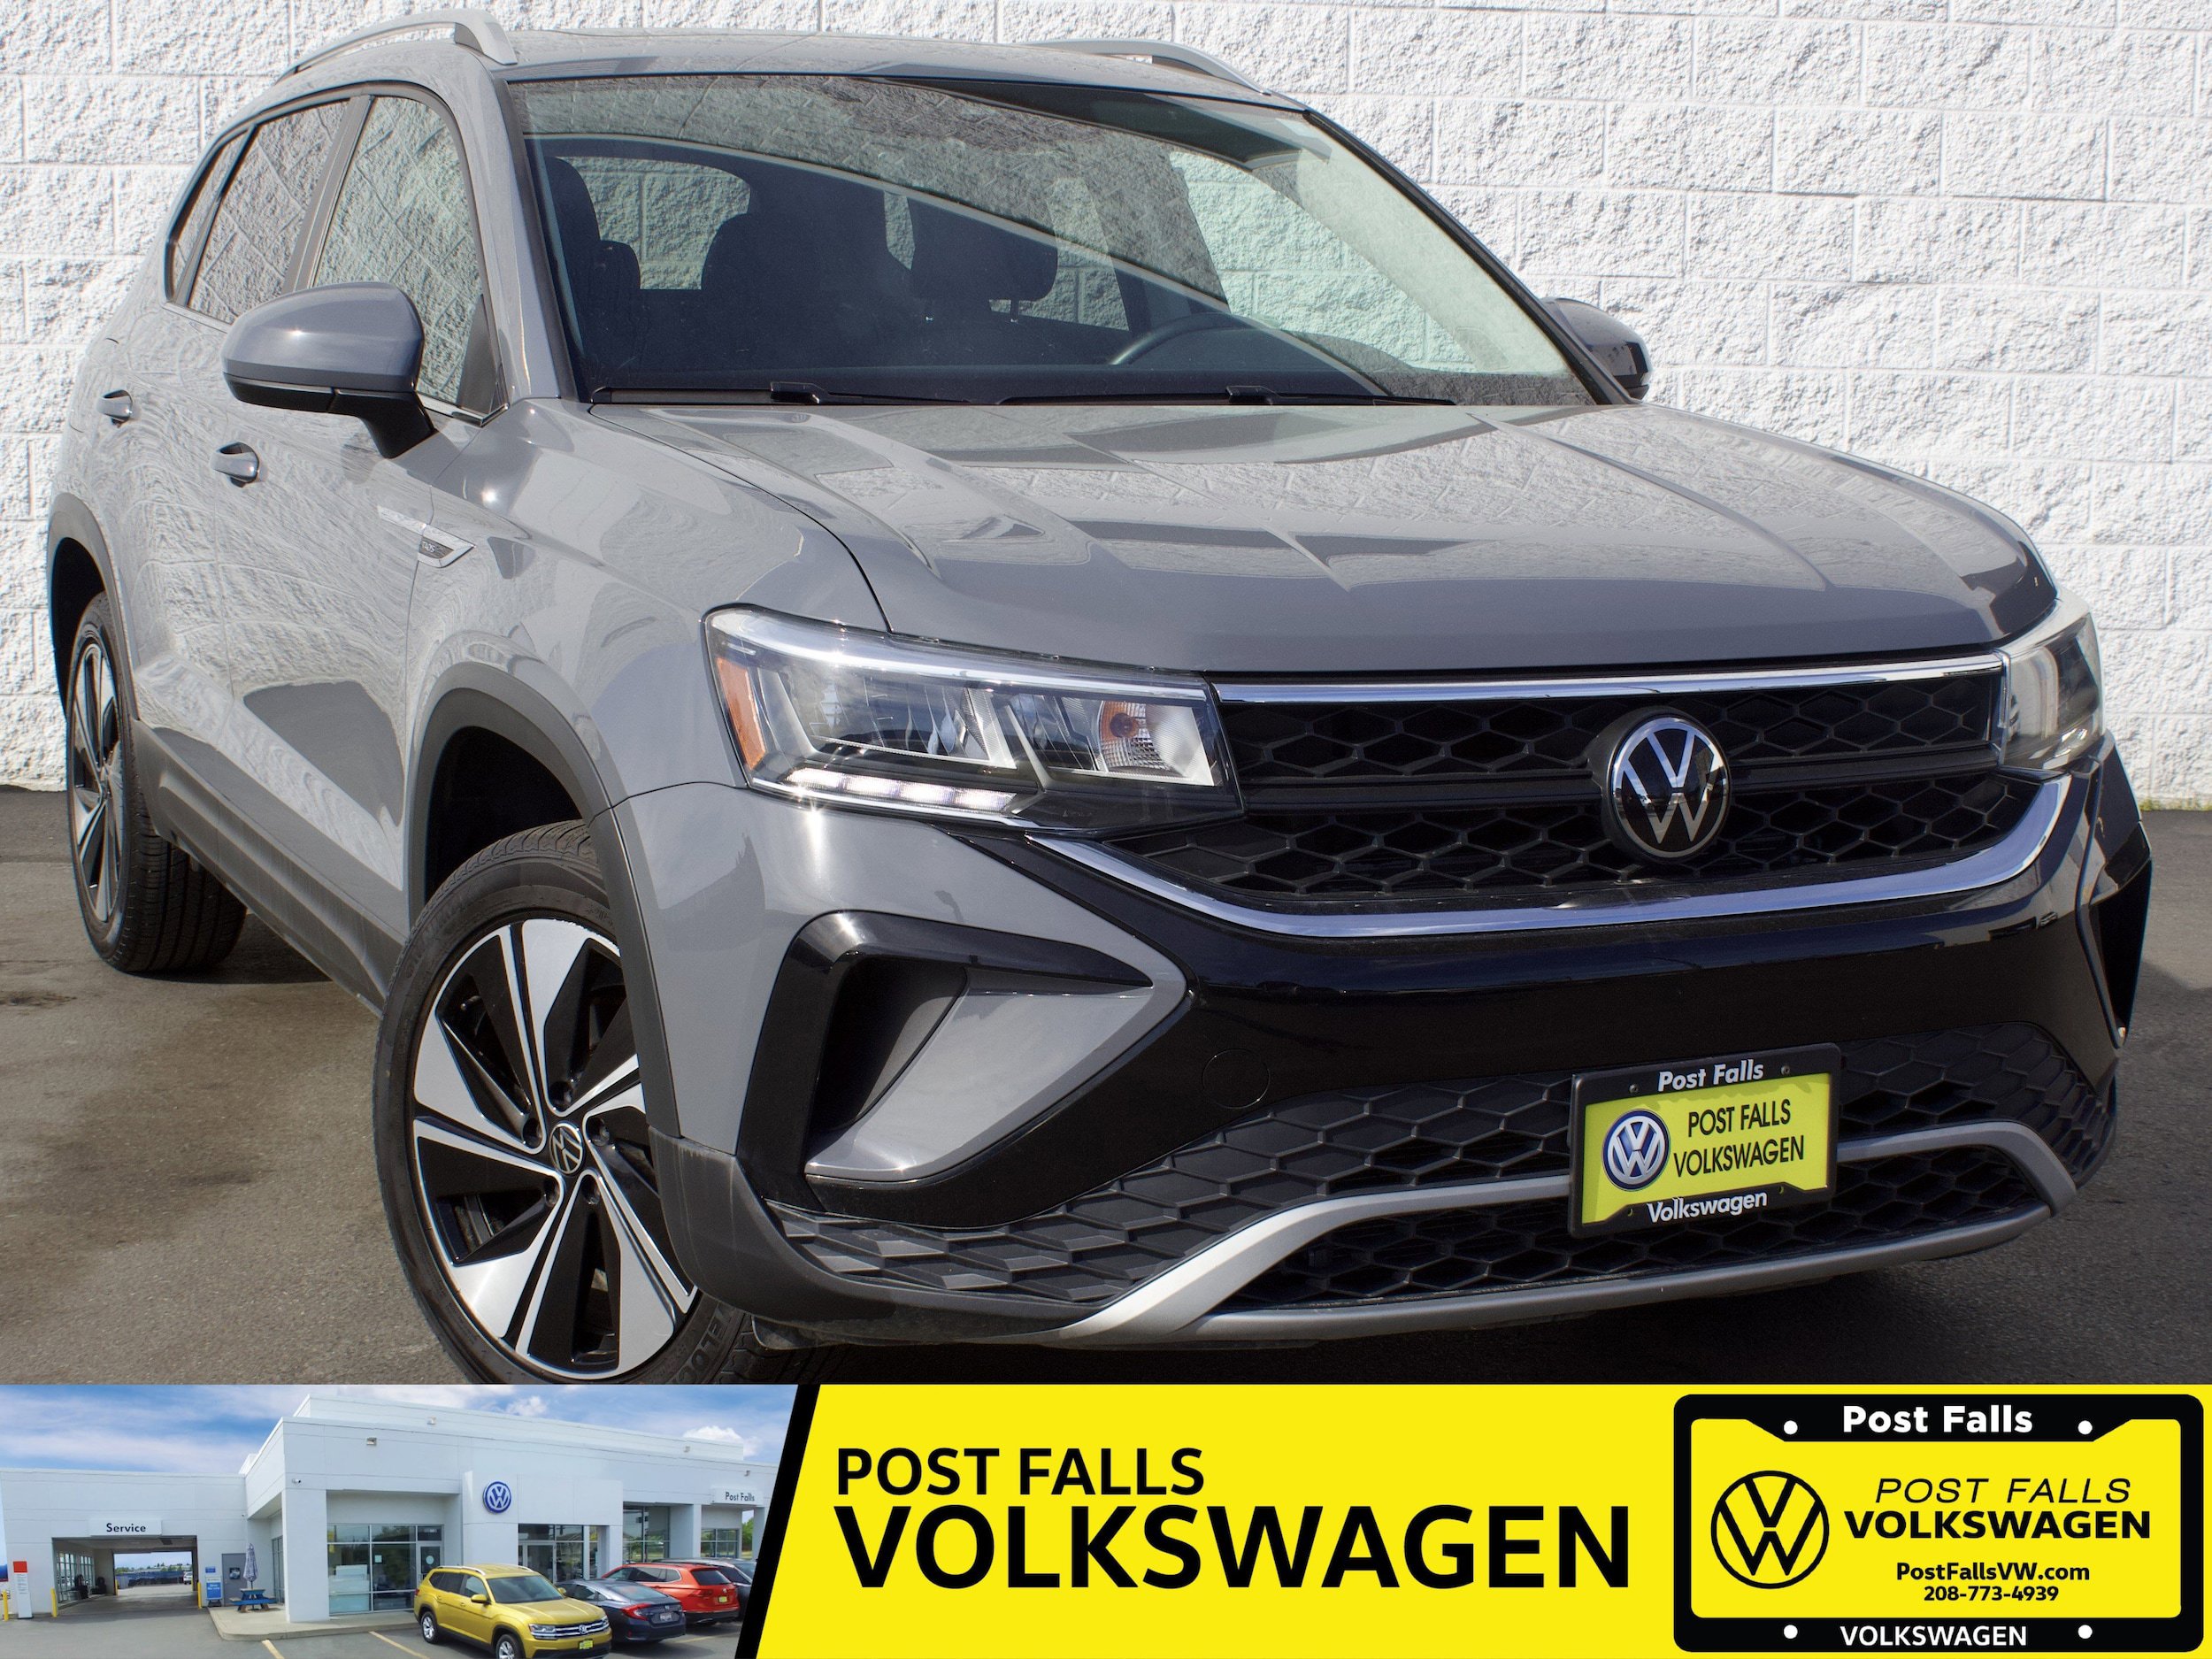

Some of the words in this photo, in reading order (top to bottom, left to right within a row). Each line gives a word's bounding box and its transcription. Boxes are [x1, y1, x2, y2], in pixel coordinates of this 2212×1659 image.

[1611, 715, 1729, 858] VW
[1657, 1068, 1707, 1093] Post
[1713, 1059, 1765, 1086] Falls
[1688, 1106, 1735, 1138] POST
[1740, 1098, 1792, 1131] FALLS
[1603, 1110, 1670, 1189] VW
[1673, 1134, 1805, 1178] VOLKSWAGEN
[1647, 1192, 1768, 1224] Volkswagen
[483, 1480, 512, 1514] VW
[725, 1491, 739, 1502] Post
[740, 1492, 755, 1502] Falls
[106, 1522, 146, 1532] Service
